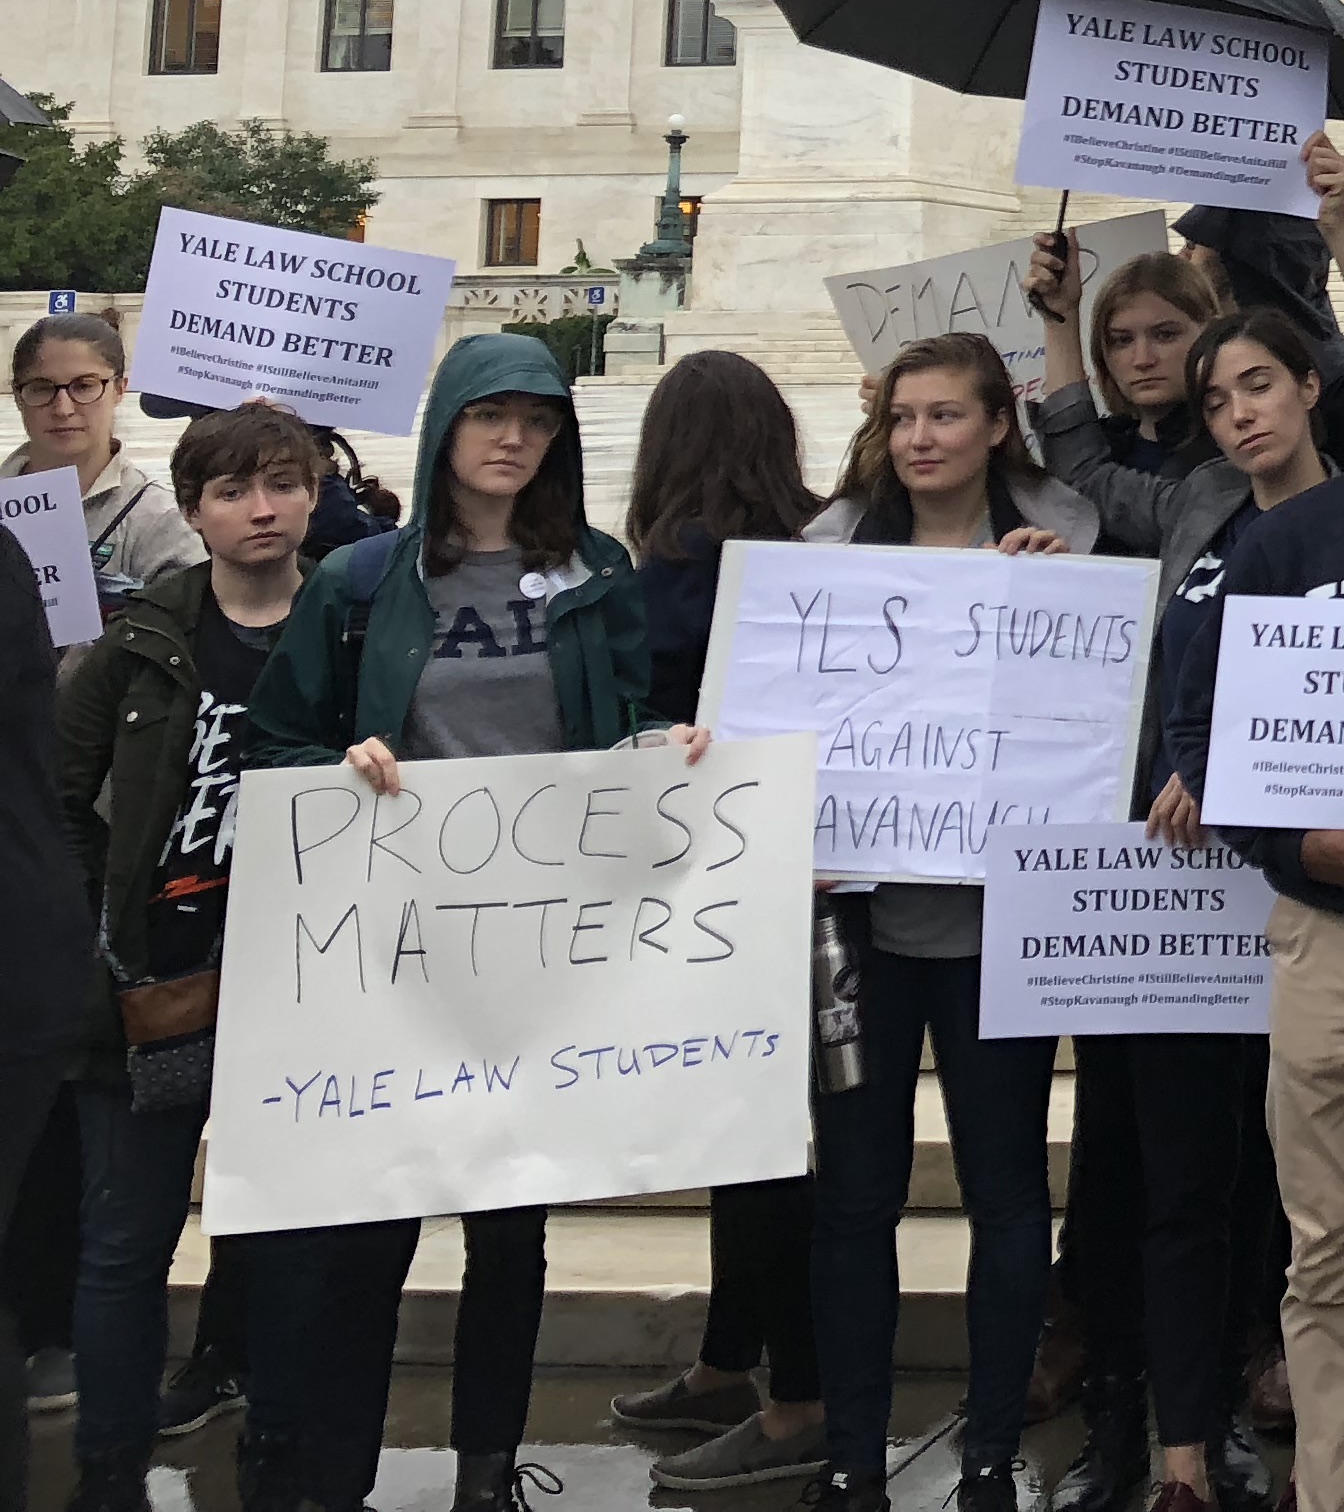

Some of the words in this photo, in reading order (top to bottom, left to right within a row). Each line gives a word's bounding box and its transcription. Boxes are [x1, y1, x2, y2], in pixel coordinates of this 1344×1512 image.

[1067, 13, 1136, 42] YALE
[1142, 24, 1205, 51] LAW
[1210, 34, 1310, 71] SCHOOL
[1114, 60, 1259, 98] STUDENTS
[1060, 95, 1183, 131] DEMAND
[1191, 112, 1298, 145] BETTER
[180, 232, 240, 263] YALE
[244, 246, 307, 274] LAW
[311, 259, 422, 295] SCHOOL
[216, 279, 359, 322] STUDENTS
[169, 309, 275, 347] DEMAND
[282, 332, 395, 367] BETTER
[0, 492, 57, 520] OOL
[790, 588, 908, 675] YLS
[954, 603, 1137, 666] STUDENTS
[1251, 623, 1324, 650] YALE
[826, 718, 1011, 772] AGAINST
[291, 781, 759, 885] PROCESS
[813, 794, 1050, 855] AVANAU
[1014, 847, 1088, 872] YALE
[1096, 847, 1163, 870] LAW
[1170, 847, 1262, 870] SCHO
[1072, 888, 1225, 912] STUDENTS
[296, 897, 739, 1004] MATTERS
[1020, 935, 1150, 959] DEMAND
[1158, 934, 1271, 956] BETTER
[1026, 974, 1134, 987] #IBelieveChristine
[1138, 973, 1264, 986] #IStillBelieveAnitaHill
[1040, 995, 1138, 1008] #StopKavanaugh
[1141, 993, 1249, 1006] #DemandingBetter
[414, 1056, 519, 1101] LAW
